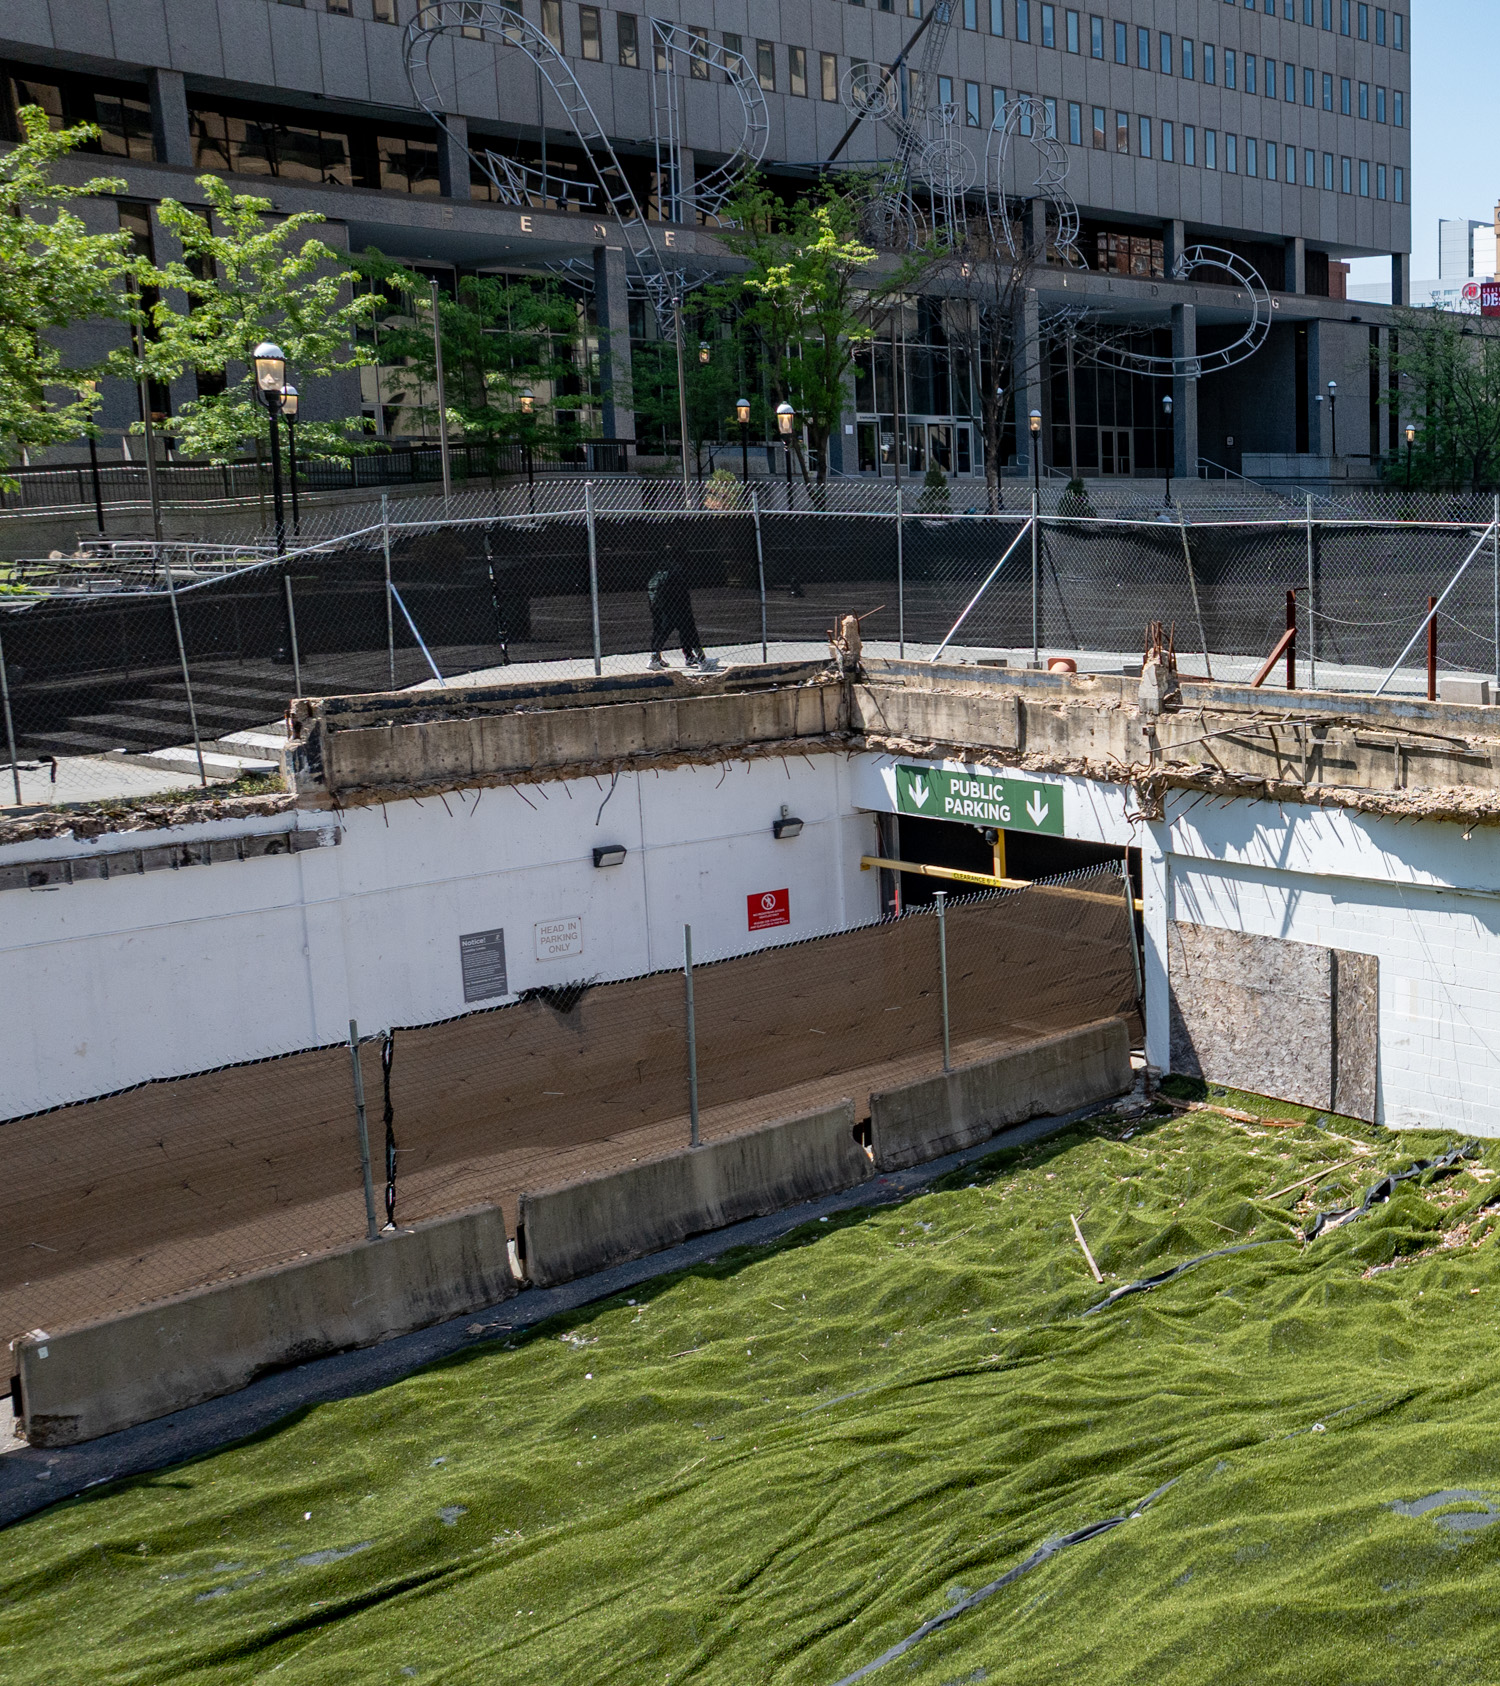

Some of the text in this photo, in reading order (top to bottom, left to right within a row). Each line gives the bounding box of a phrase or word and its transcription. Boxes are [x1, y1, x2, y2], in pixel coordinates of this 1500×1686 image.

[950, 778, 1004, 802] PUBLIC
[945, 797, 1011, 822] PARKING
[953, 872, 986, 884] CLEARANCE
[541, 922, 577, 935] HEAD IN
[462, 937, 486, 948] Notice!
[540, 932, 578, 945] PARKING
[549, 942, 571, 954] ONLY
